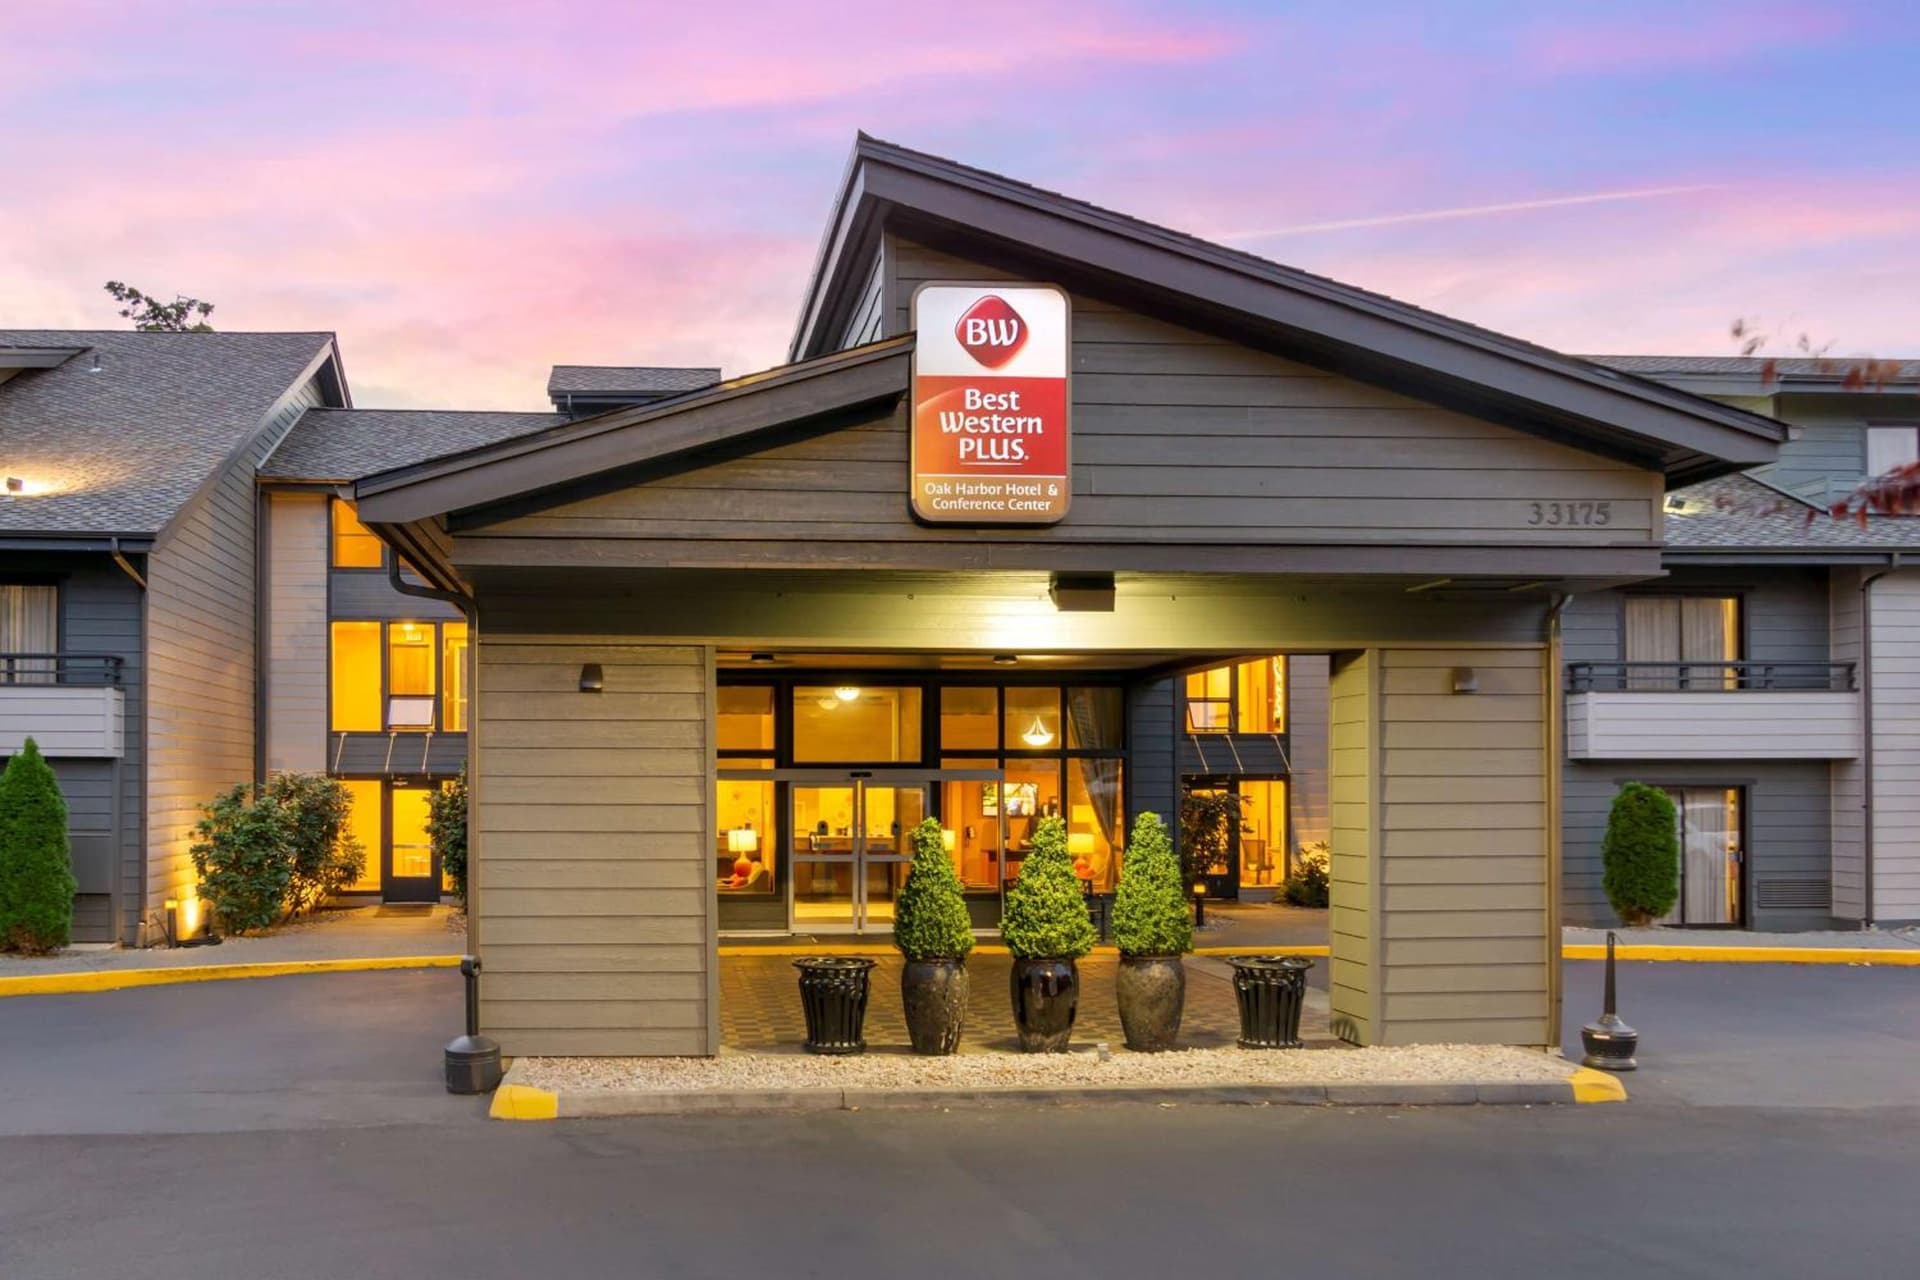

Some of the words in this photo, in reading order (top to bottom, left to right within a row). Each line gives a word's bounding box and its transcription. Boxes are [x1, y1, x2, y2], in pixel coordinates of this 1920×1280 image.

[966, 318, 1019, 346] BW
[964, 388, 1021, 411] Best
[939, 411, 1044, 434] Western
[924, 482, 952, 495] Oak
[955, 482, 1002, 496] Harbor
[1005, 483, 1042, 496] Hotel
[1047, 483, 1058, 496] &
[932, 497, 1005, 510] Conference
[1008, 498, 1052, 511] Center
[1527, 502, 1611, 526] 33175
